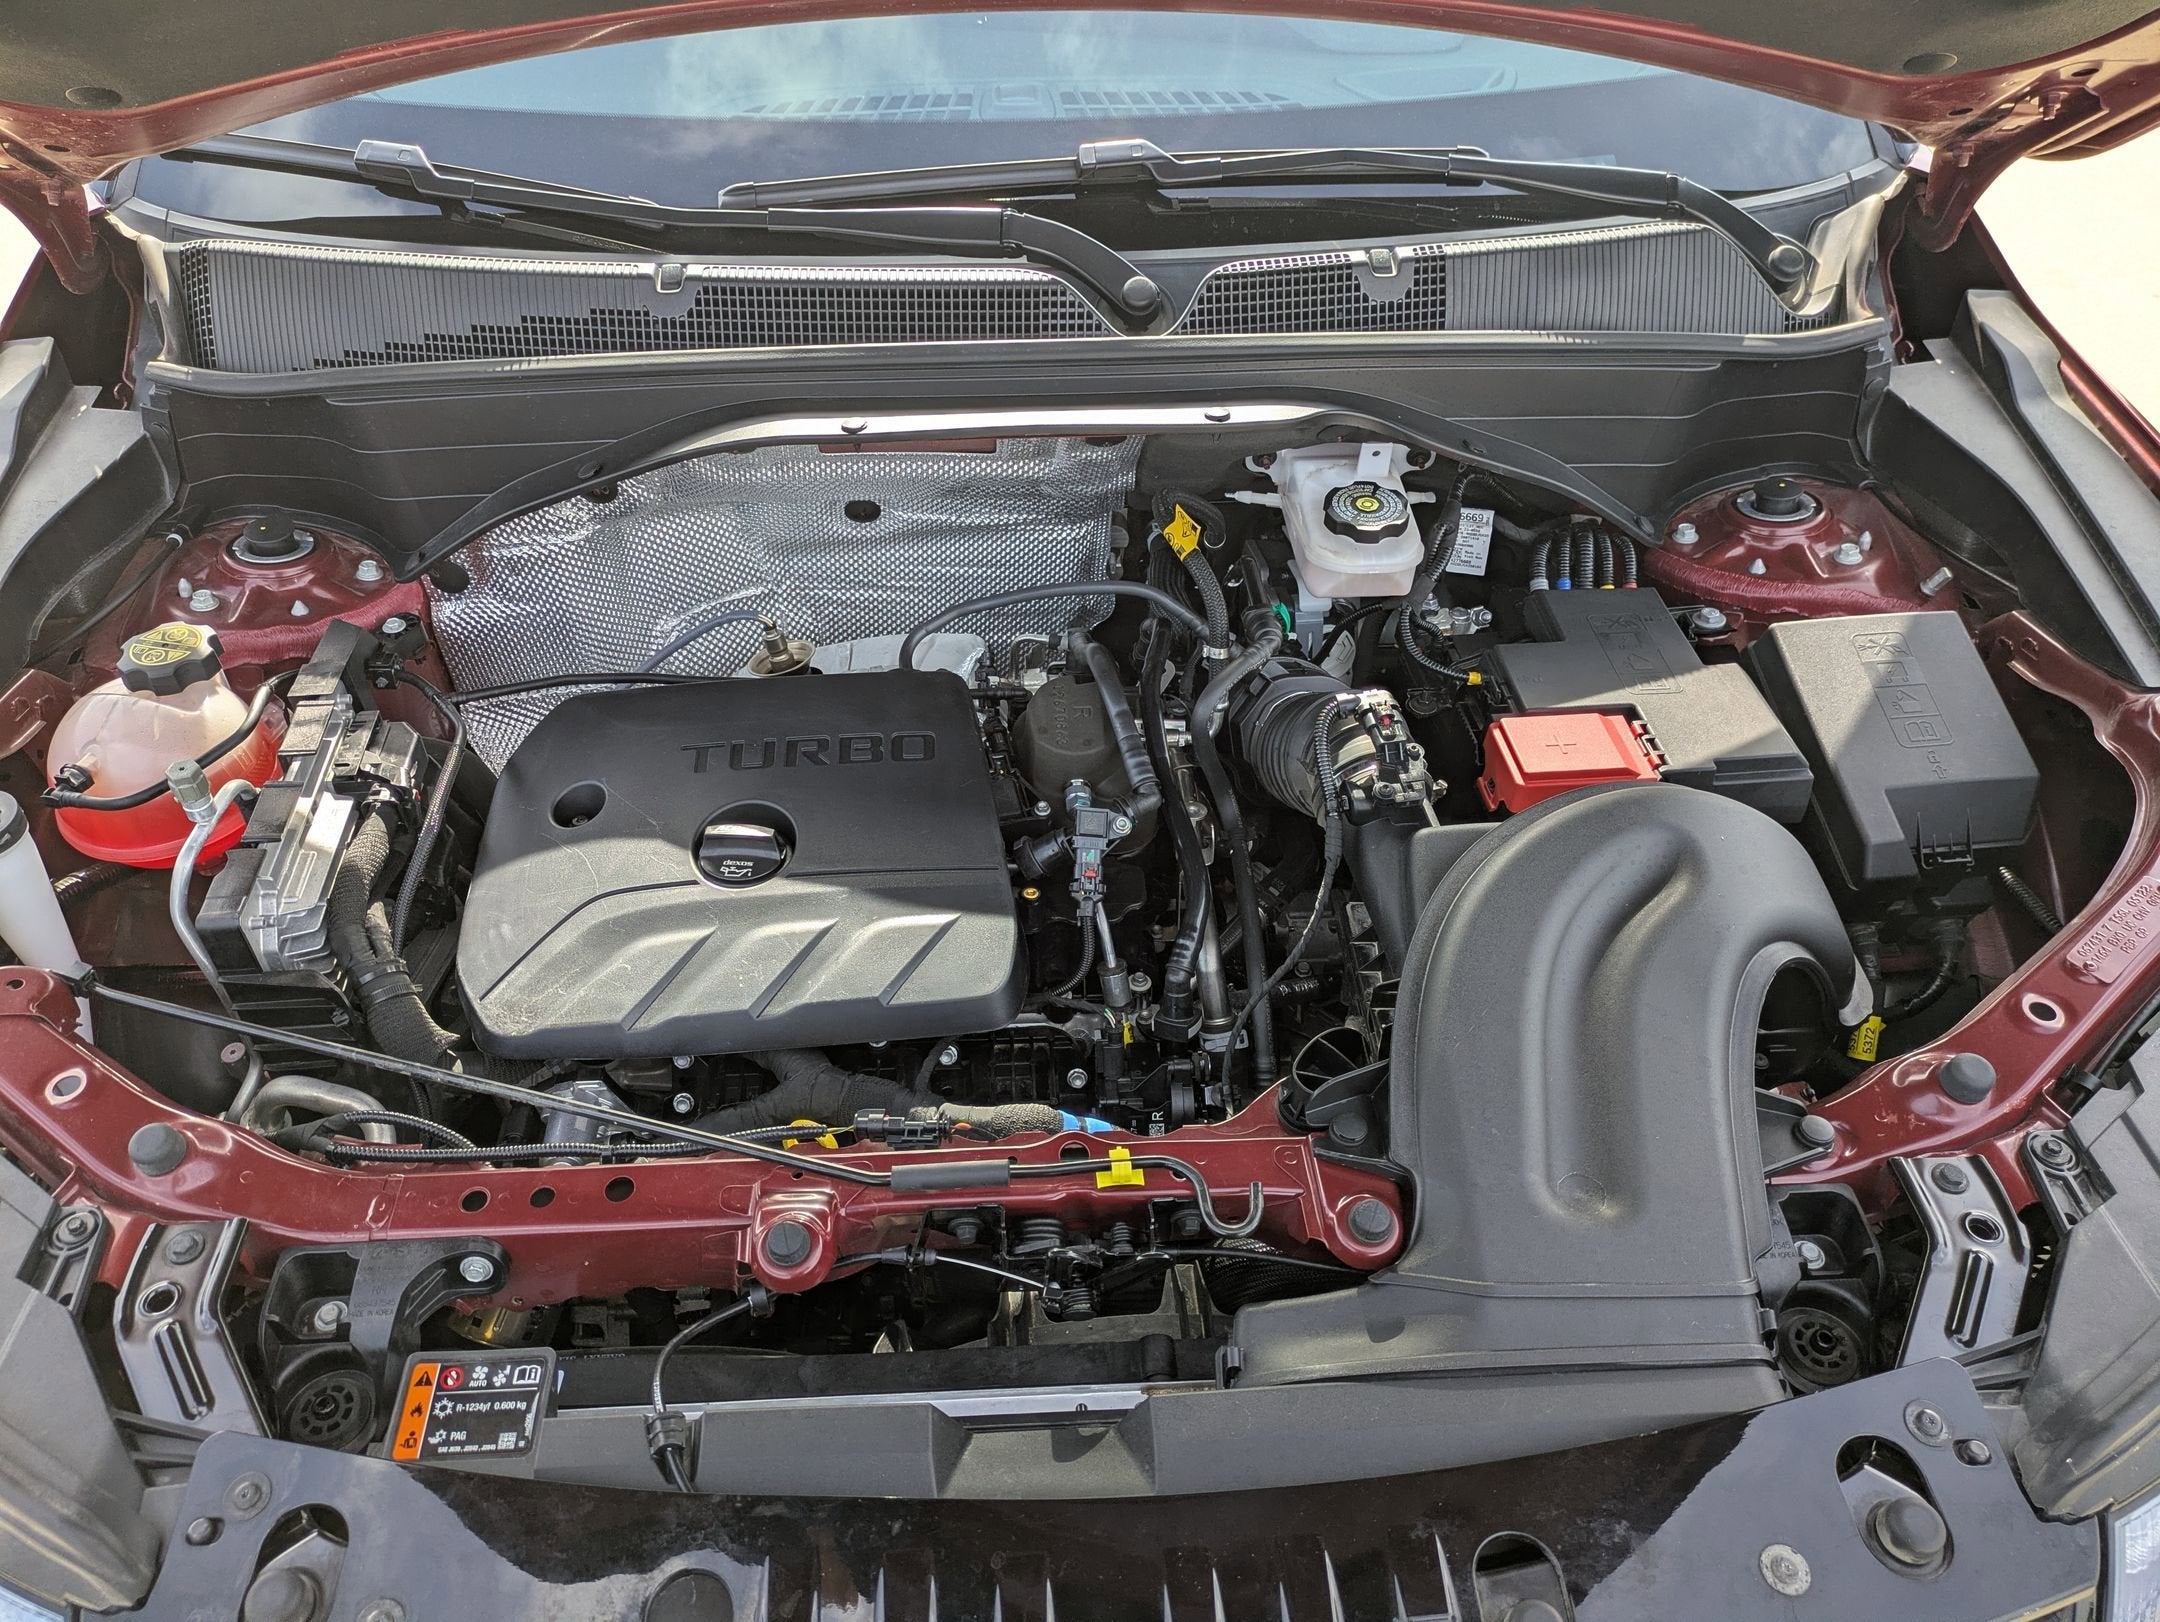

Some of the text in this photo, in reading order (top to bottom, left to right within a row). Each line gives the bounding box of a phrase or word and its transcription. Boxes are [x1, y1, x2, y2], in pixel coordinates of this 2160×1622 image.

[680, 731, 936, 774] TURBO
[723, 859, 754, 867] dexos
[1862, 1027, 1876, 1055] 5372
[1151, 1111, 1164, 1121] R
[468, 1379, 488, 1388] AUTO
[456, 1400, 528, 1413] R-1234yf 0.600 kg
[450, 1431, 467, 1441] PAG
